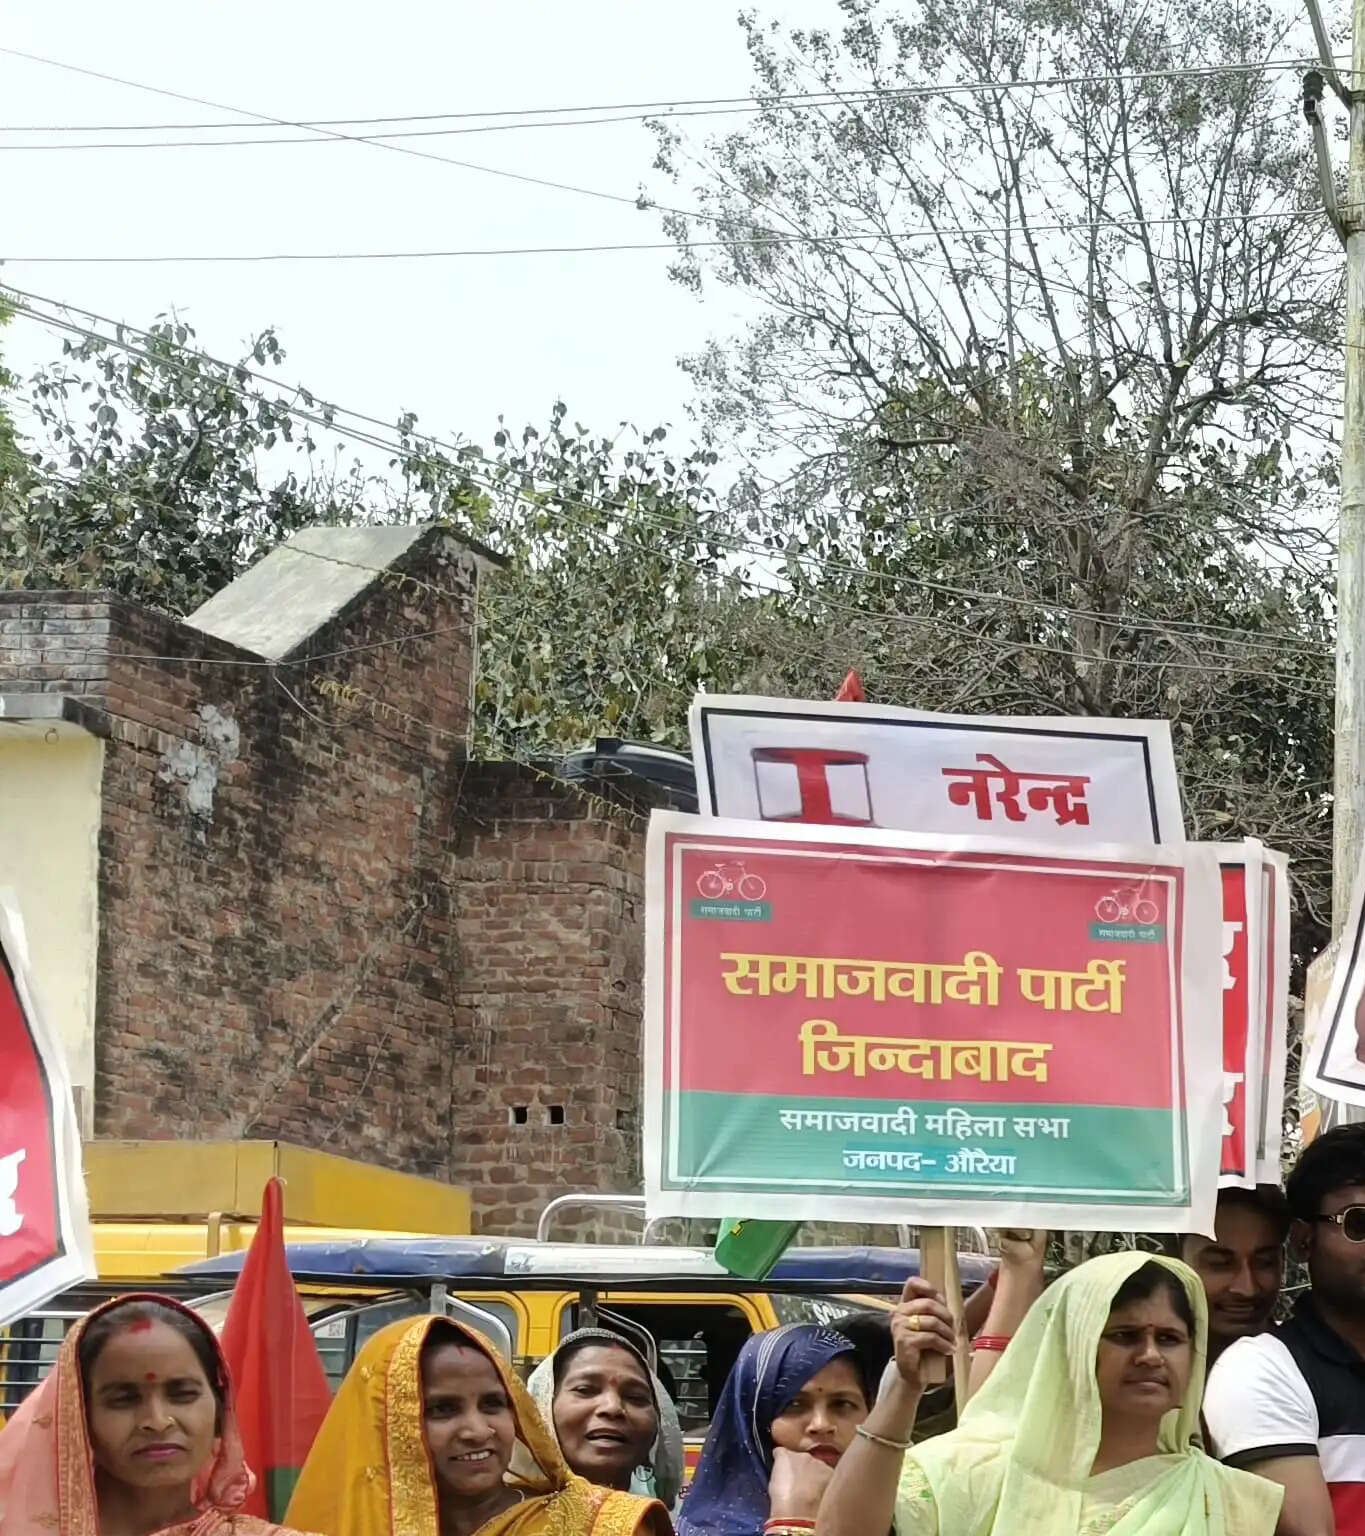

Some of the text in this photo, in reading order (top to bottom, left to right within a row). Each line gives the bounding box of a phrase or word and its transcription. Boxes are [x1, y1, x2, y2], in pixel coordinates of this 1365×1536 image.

[942, 754, 1091, 826] नरेन्द्र
[720, 951, 1127, 1014] समाजवादी पार्टी
[798, 1019, 1053, 1083] जिन्दाबाद
[780, 1107, 1070, 1141] समाजवादी महिला सभा
[944, 1148, 1017, 1176] औरैया
